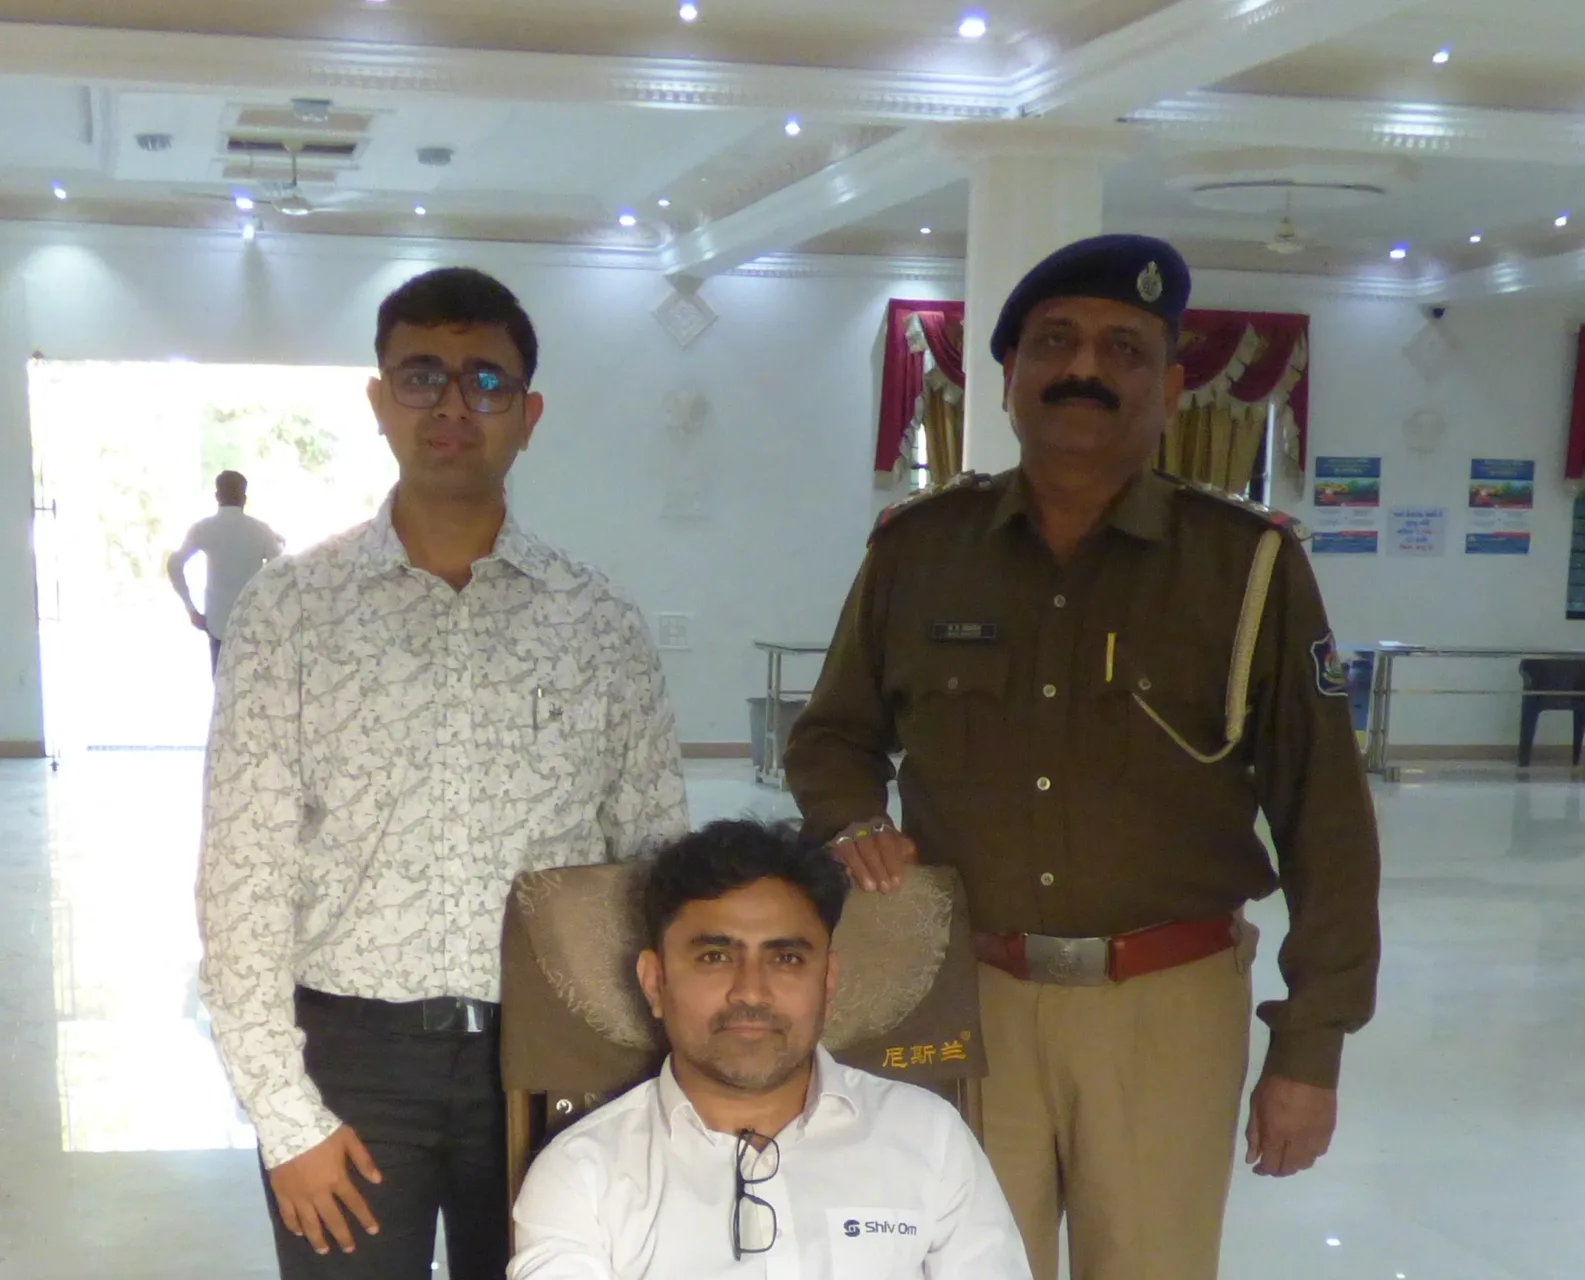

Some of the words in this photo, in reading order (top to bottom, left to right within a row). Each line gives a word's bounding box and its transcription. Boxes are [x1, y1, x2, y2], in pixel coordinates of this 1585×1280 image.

[882, 1040, 967, 1068] 尼斯兰
[864, 1220, 896, 1234] Shiv
[898, 1222, 917, 1236] Om
